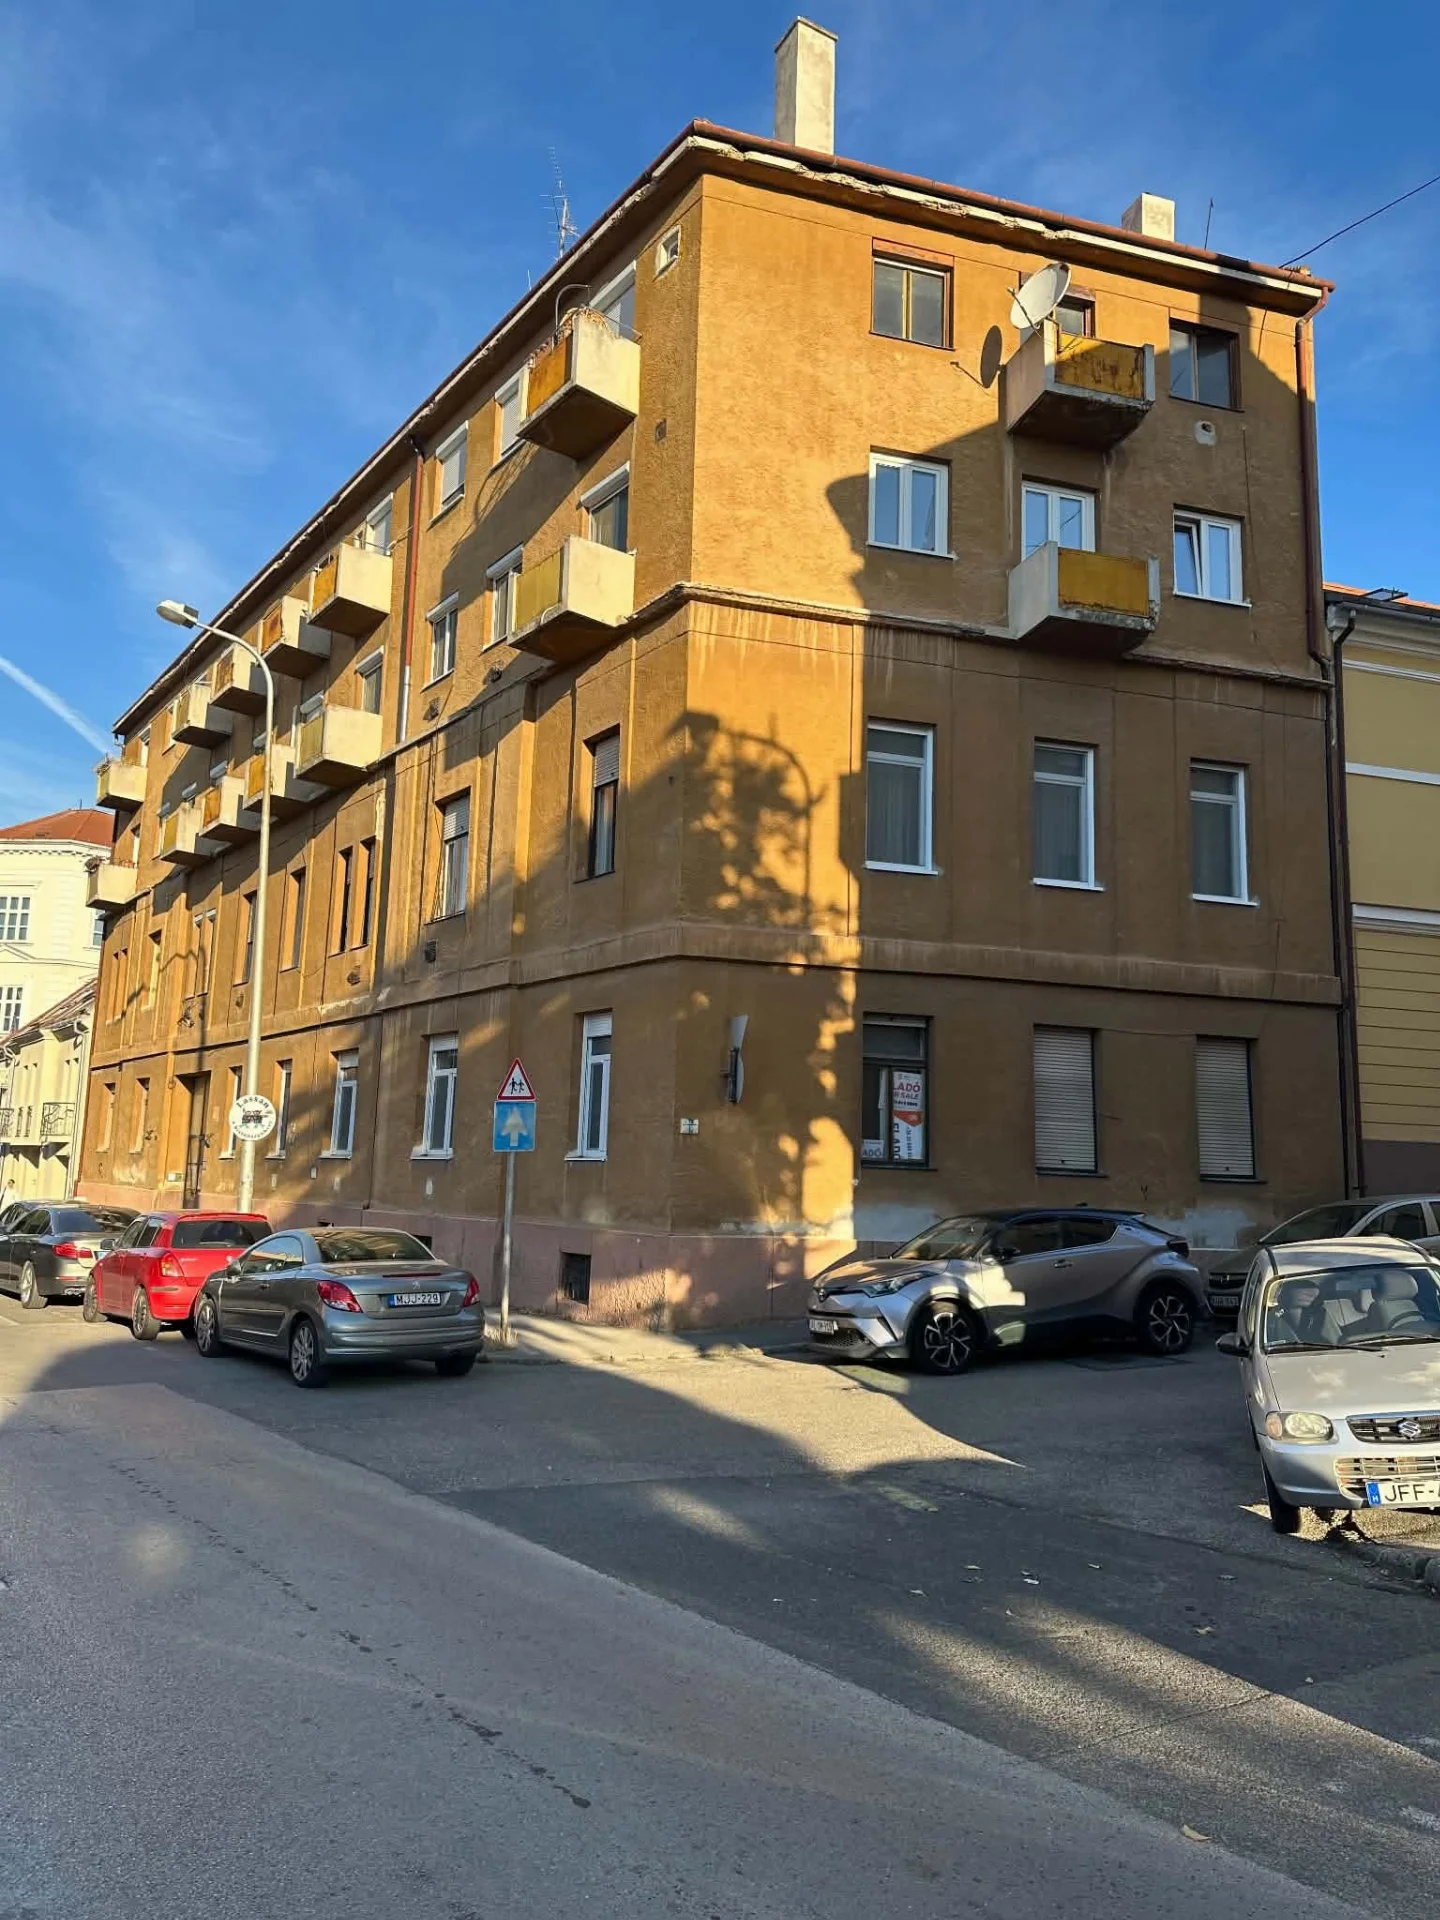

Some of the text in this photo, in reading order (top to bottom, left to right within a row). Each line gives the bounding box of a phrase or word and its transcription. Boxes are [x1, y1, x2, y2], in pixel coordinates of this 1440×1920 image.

[892, 1082, 920, 1092] LADÓ
[236, 1096, 269, 1108] Lassan
[396, 1293, 438, 1304] MJJ-229
[1385, 1484, 1440, 1501] JFF-
